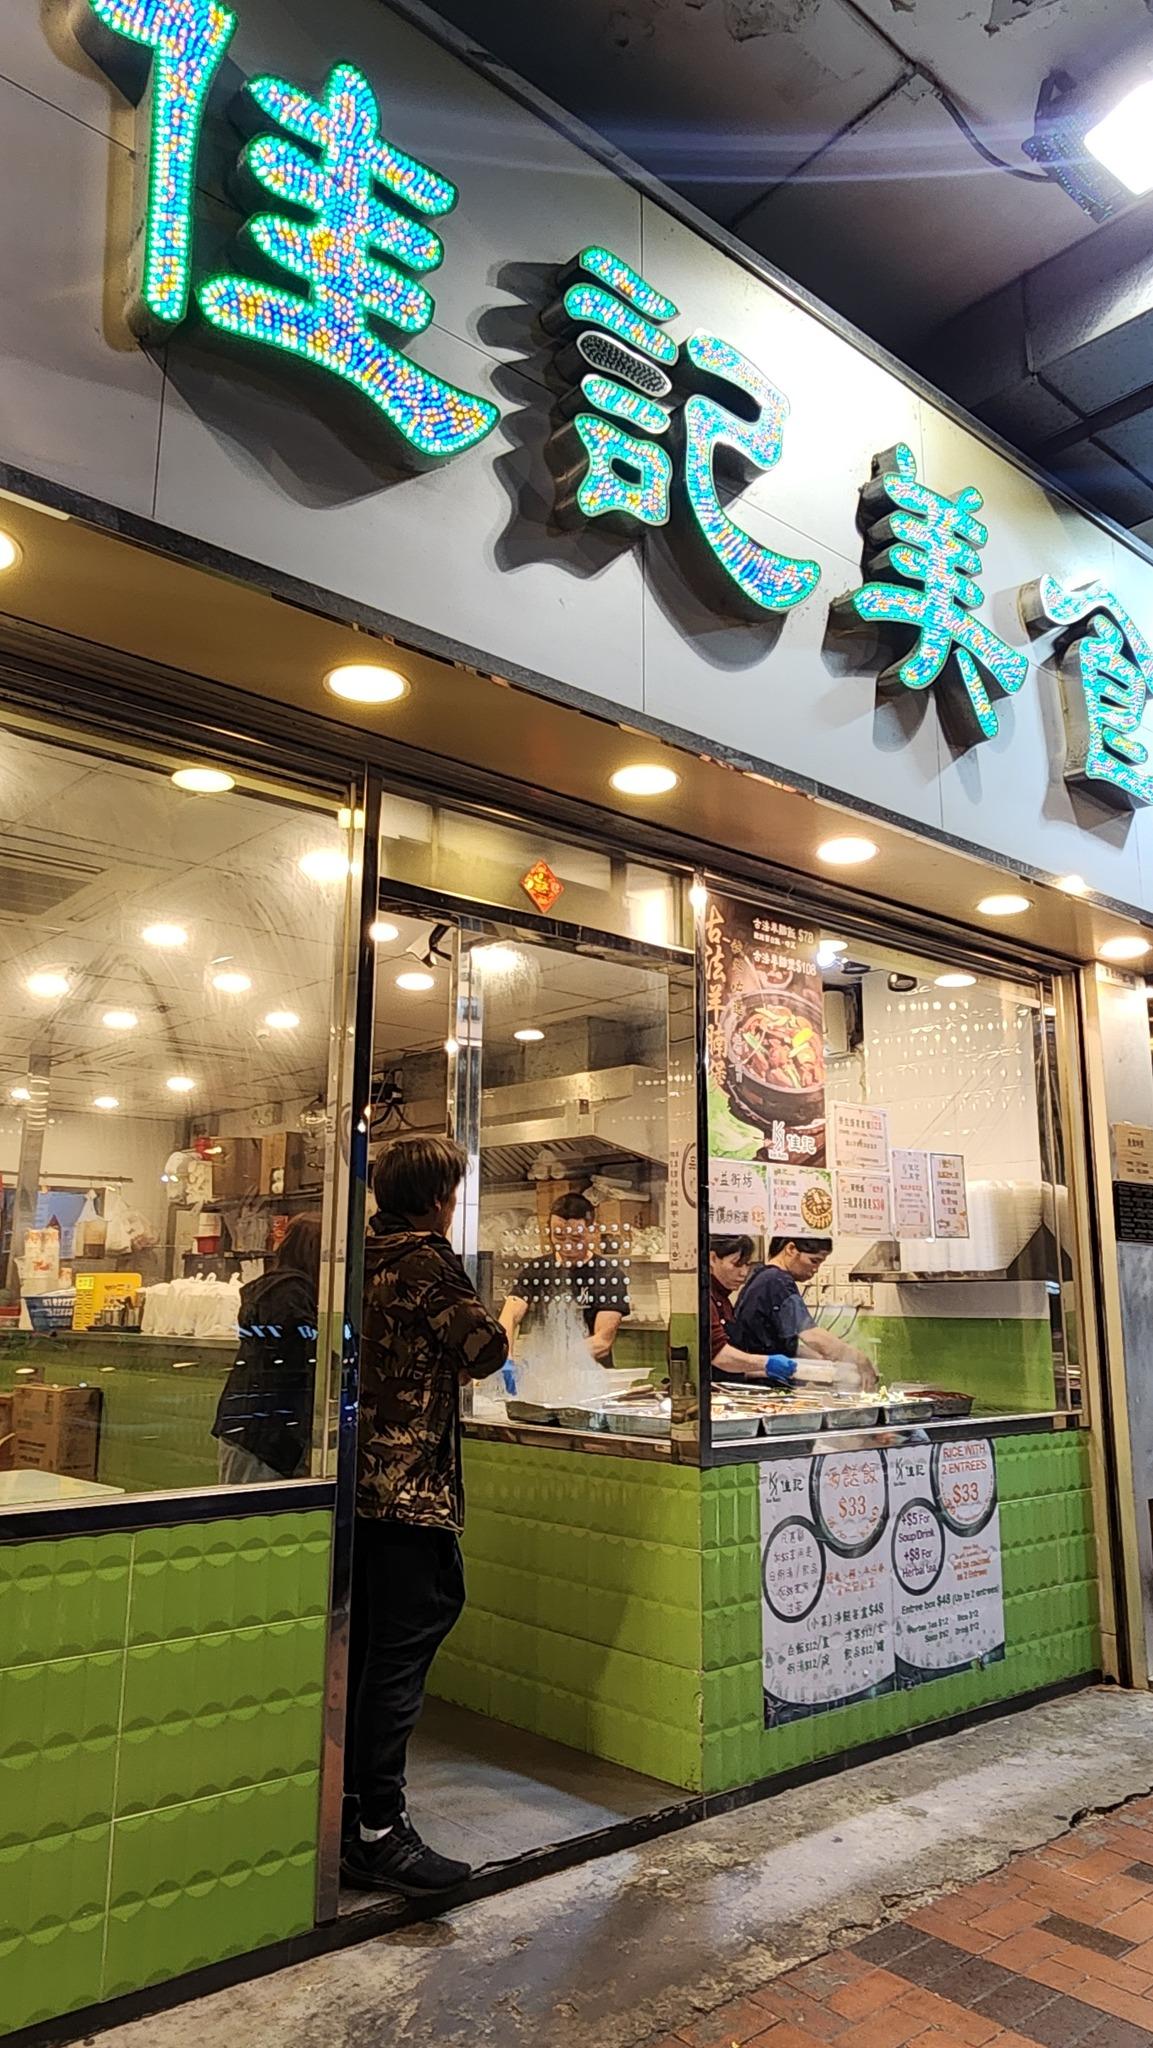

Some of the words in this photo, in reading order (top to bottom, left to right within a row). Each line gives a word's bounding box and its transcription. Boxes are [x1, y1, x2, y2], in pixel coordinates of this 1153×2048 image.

[943, 1446, 964, 1458] RICE
[964, 1444, 986, 1455] WITH
[941, 1465, 948, 1475] 2
[949, 1460, 987, 1474] ENTREES
[952, 1482, 979, 1504] $33
[838, 1495, 866, 1519] $33
[919, 1514, 930, 1525] For
[921, 1548, 933, 1559] For
[901, 1602, 923, 1615] Entree
